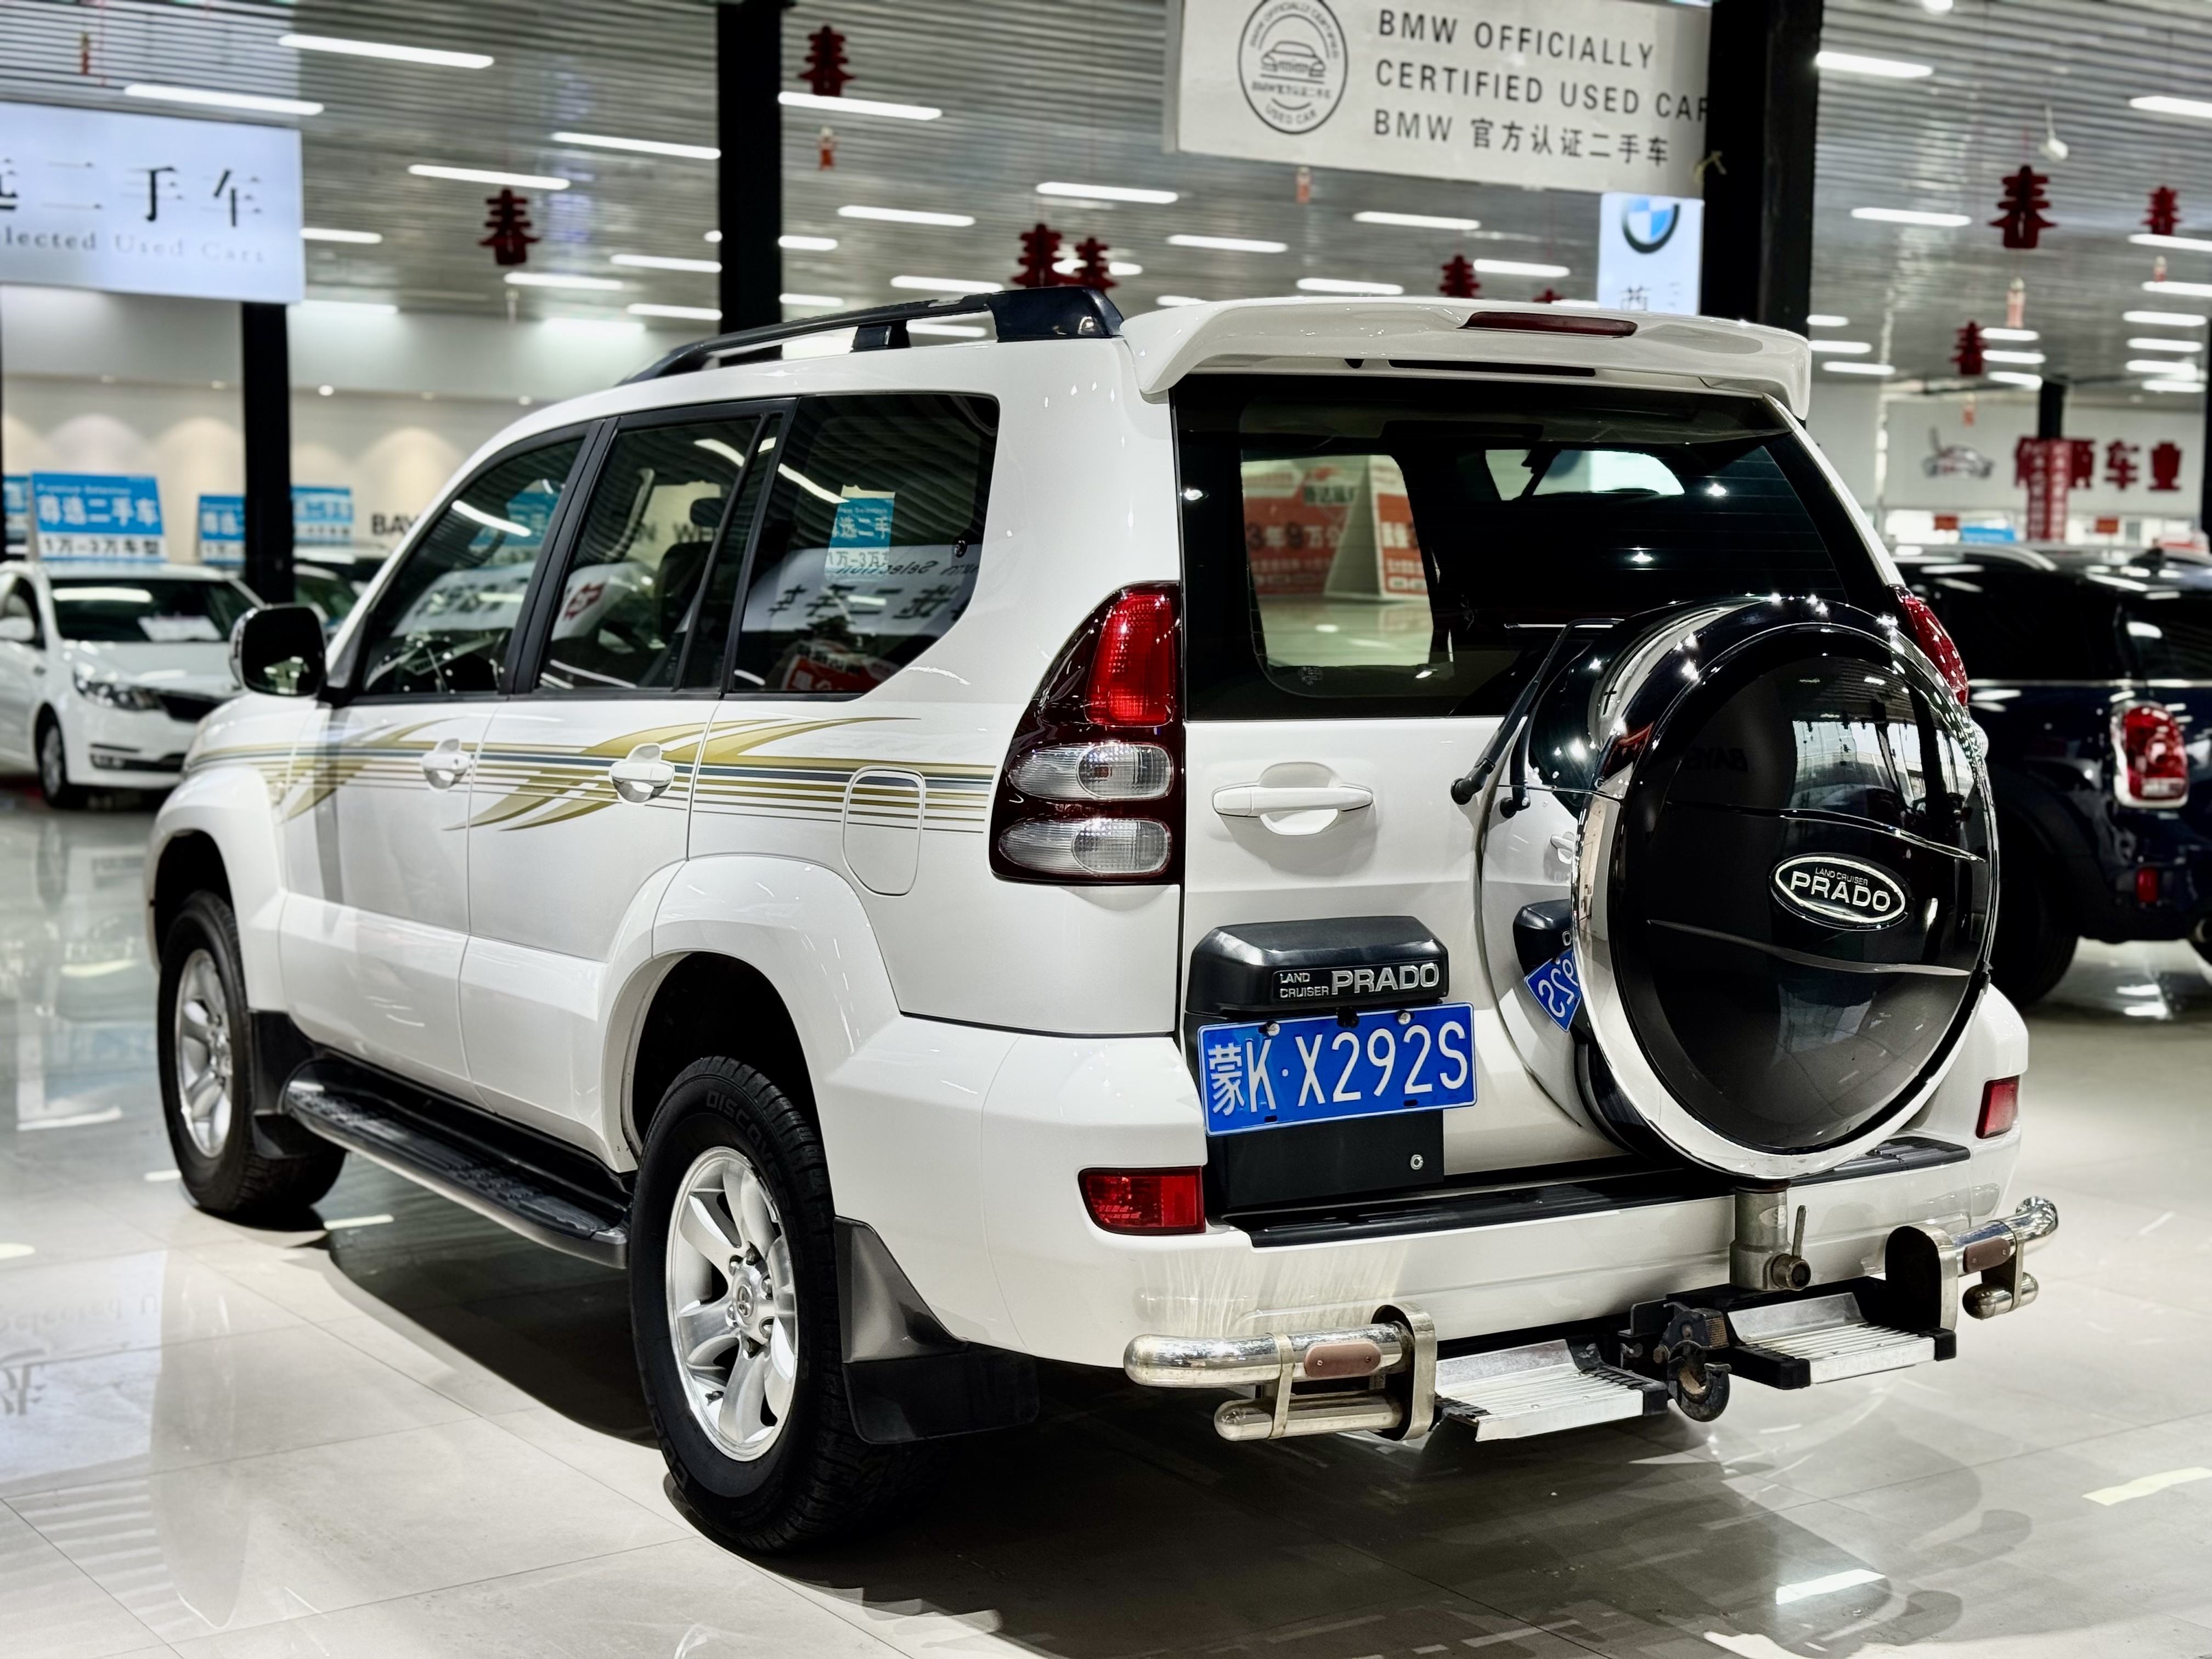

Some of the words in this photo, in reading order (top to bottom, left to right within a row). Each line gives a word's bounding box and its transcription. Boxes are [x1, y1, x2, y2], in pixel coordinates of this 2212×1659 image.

[1379, 9, 1458, 44] BMW
[1474, 21, 1654, 69] OFFICIALLY
[1376, 58, 1542, 104] CERTIFIED
[1560, 81, 1639, 115] USED
[1374, 109, 1453, 143] BMW
[1470, 117, 1669, 167] 官方认证二手车
[5, 225, 97, 251] lected
[1790, 871, 1891, 912] PRADO
[1815, 867, 1836, 878] LAND
[1836, 872, 1869, 887] CRUISER
[1279, 972, 1311, 984] LAND
[1279, 986, 1329, 998] CRUISER
[1331, 962, 1440, 996] PRADO
[1207, 1020, 1469, 1116] 蒙K·X292S
